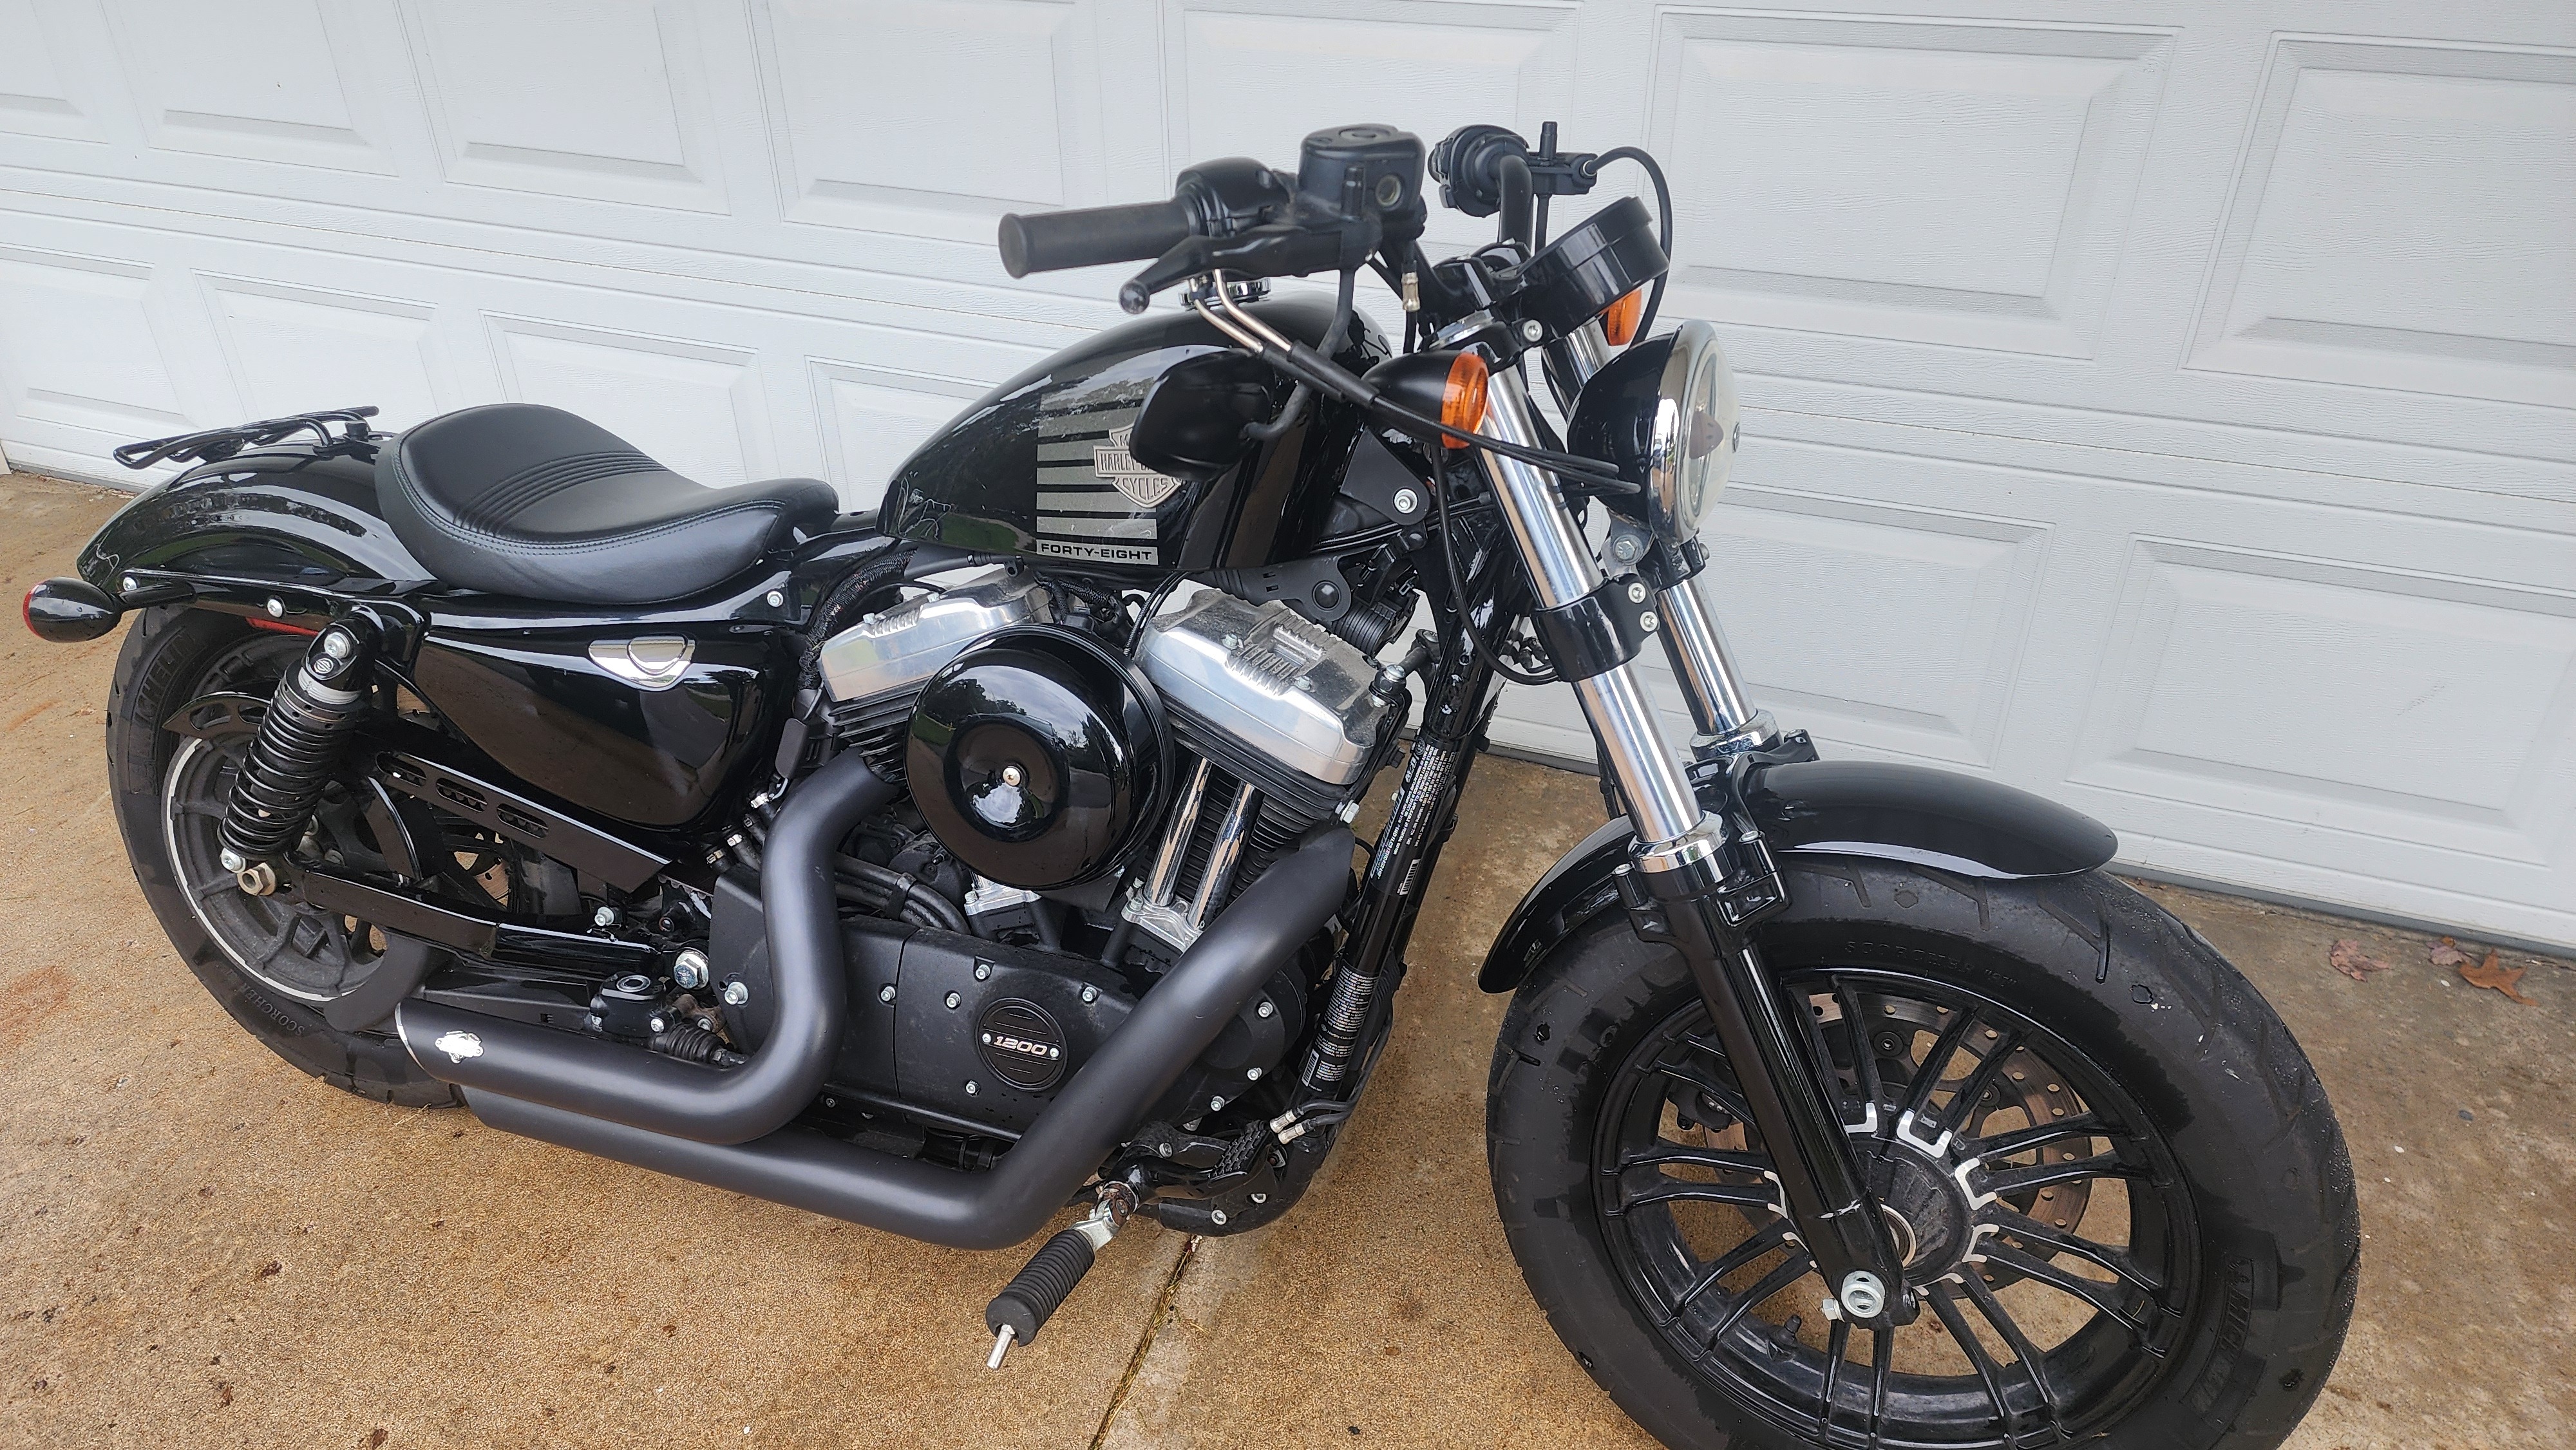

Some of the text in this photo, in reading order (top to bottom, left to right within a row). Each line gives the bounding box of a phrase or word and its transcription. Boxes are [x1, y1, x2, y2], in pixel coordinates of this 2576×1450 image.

[1041, 543, 1152, 560] FORTY-EIGHT
[243, 982, 305, 1035] SCORCHER
[994, 1036, 1047, 1055] 1200
